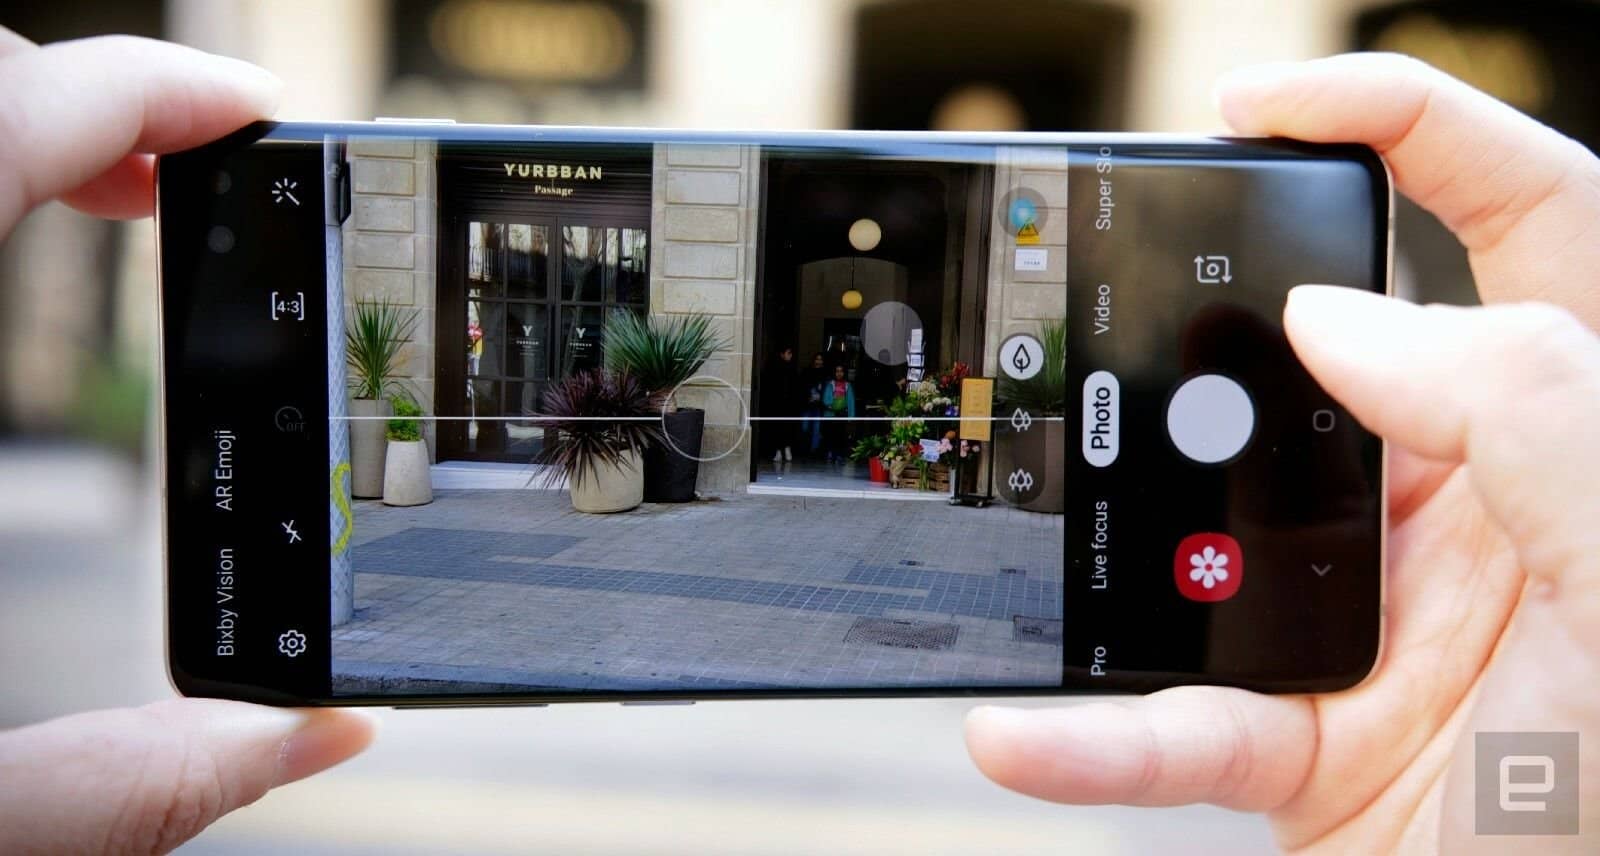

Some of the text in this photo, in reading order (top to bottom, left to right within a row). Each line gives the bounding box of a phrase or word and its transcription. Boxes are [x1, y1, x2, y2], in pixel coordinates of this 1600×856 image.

[503, 162, 602, 180] YURBBAN
[534, 184, 574, 197] Passage
[1095, 146, 1115, 231] Super Slo
[1094, 284, 1111, 335] Video
[1090, 386, 1111, 449] Photo
[214, 430, 236, 512] AR Emoji
[1091, 500, 1108, 589] Live focus
[216, 548, 239, 656] Bixby Vision
[1090, 645, 1107, 676] Pro
